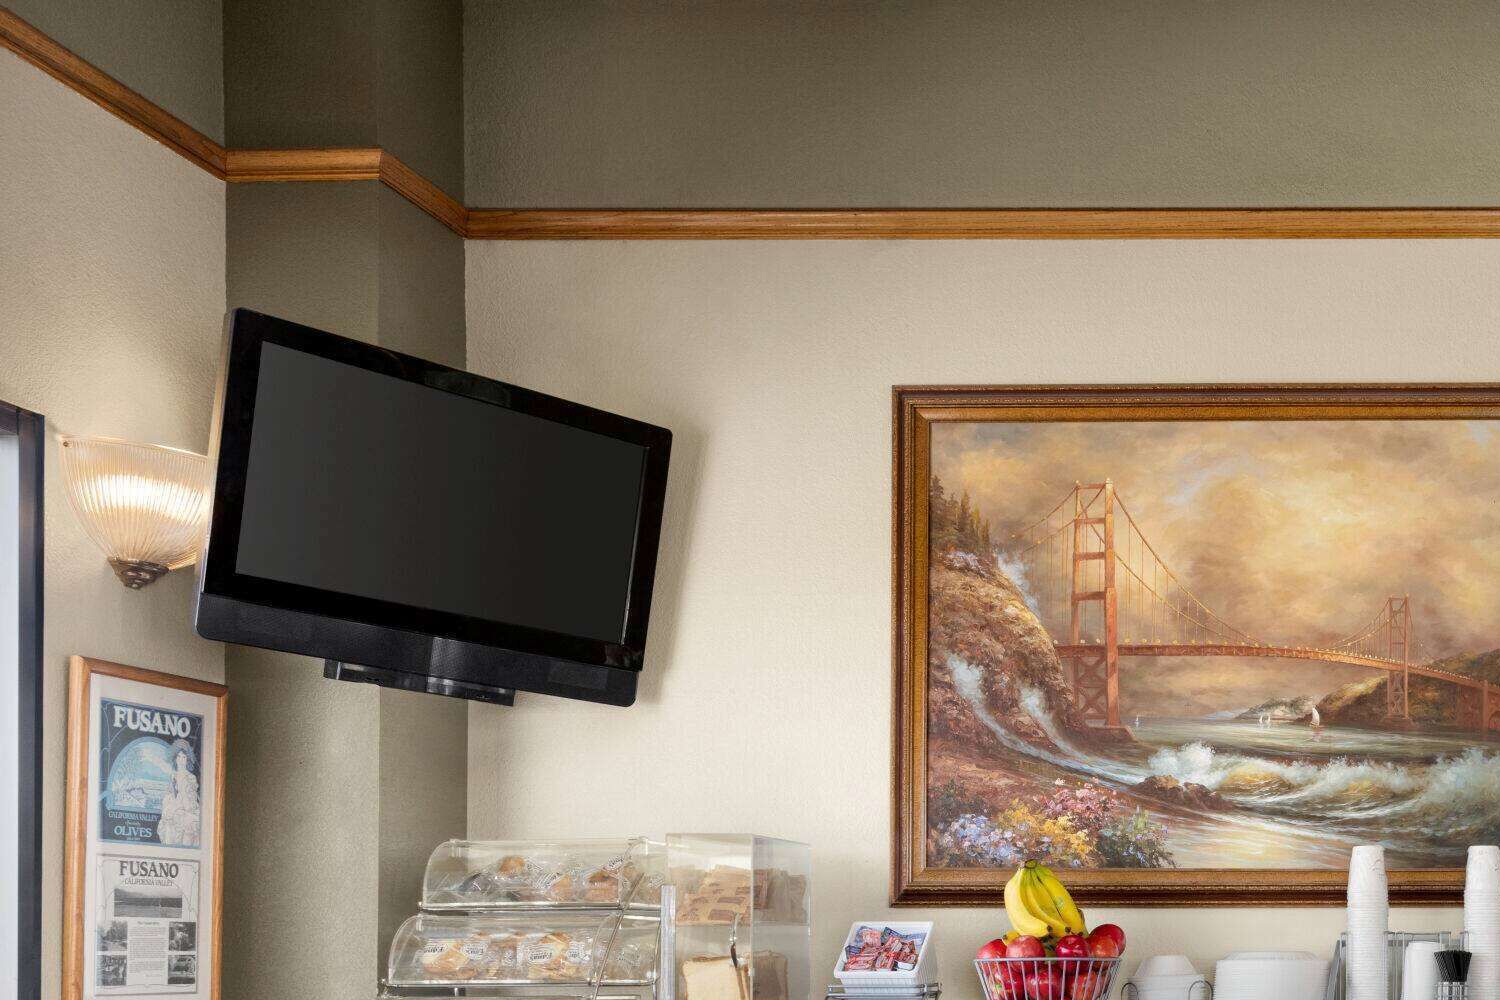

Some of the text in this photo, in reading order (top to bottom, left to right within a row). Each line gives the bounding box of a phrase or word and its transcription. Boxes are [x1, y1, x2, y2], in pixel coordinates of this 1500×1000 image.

[113, 705, 191, 738] FUSANO
[114, 825, 152, 838] OLIVES
[119, 860, 179, 878] FUSANO
[124, 878, 154, 886] CALIFORNIA
